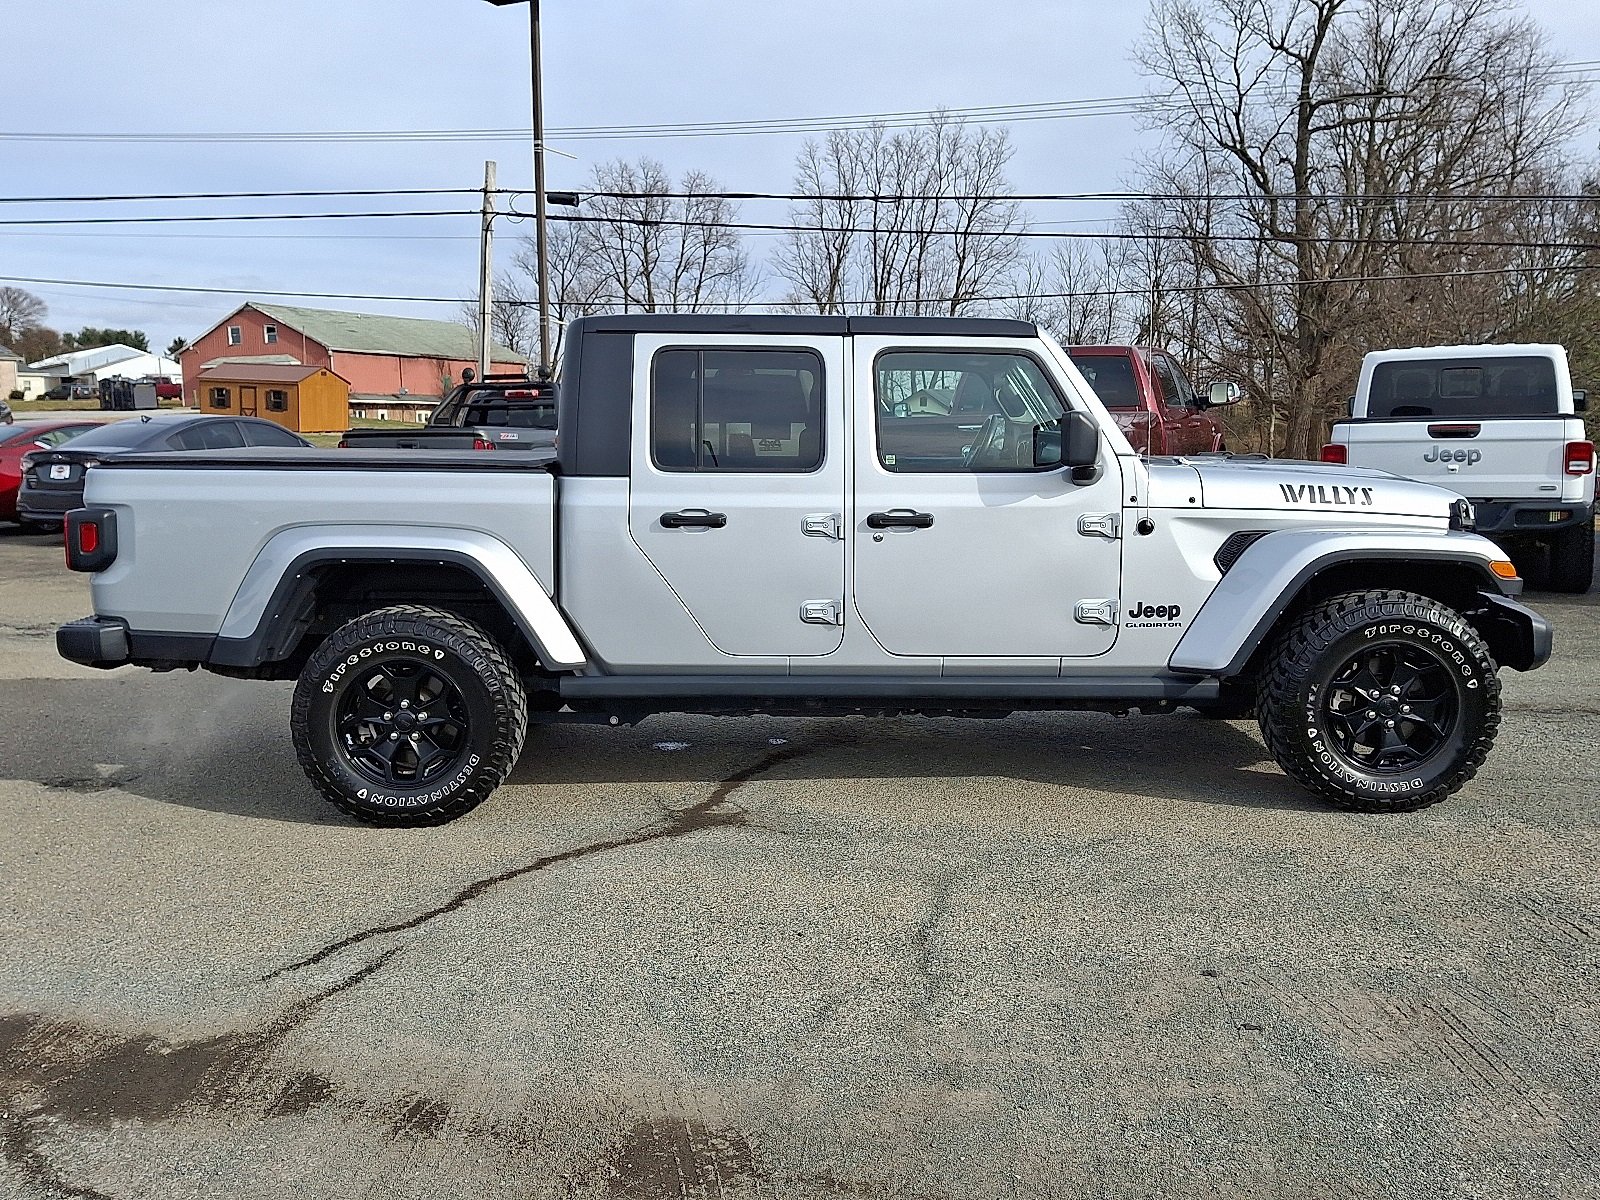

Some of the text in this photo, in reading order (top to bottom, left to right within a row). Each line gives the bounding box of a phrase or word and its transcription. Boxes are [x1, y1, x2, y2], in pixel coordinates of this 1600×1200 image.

[1423, 445, 1482, 465] Jeep
[1279, 483, 1374, 506] WILLYS
[1128, 601, 1181, 621] Jeep
[322, 641, 430, 693] Firestone
[1365, 624, 1472, 676] Firestone
[370, 753, 480, 807] DESTINATION
[1313, 740, 1423, 792] DESTINATION
